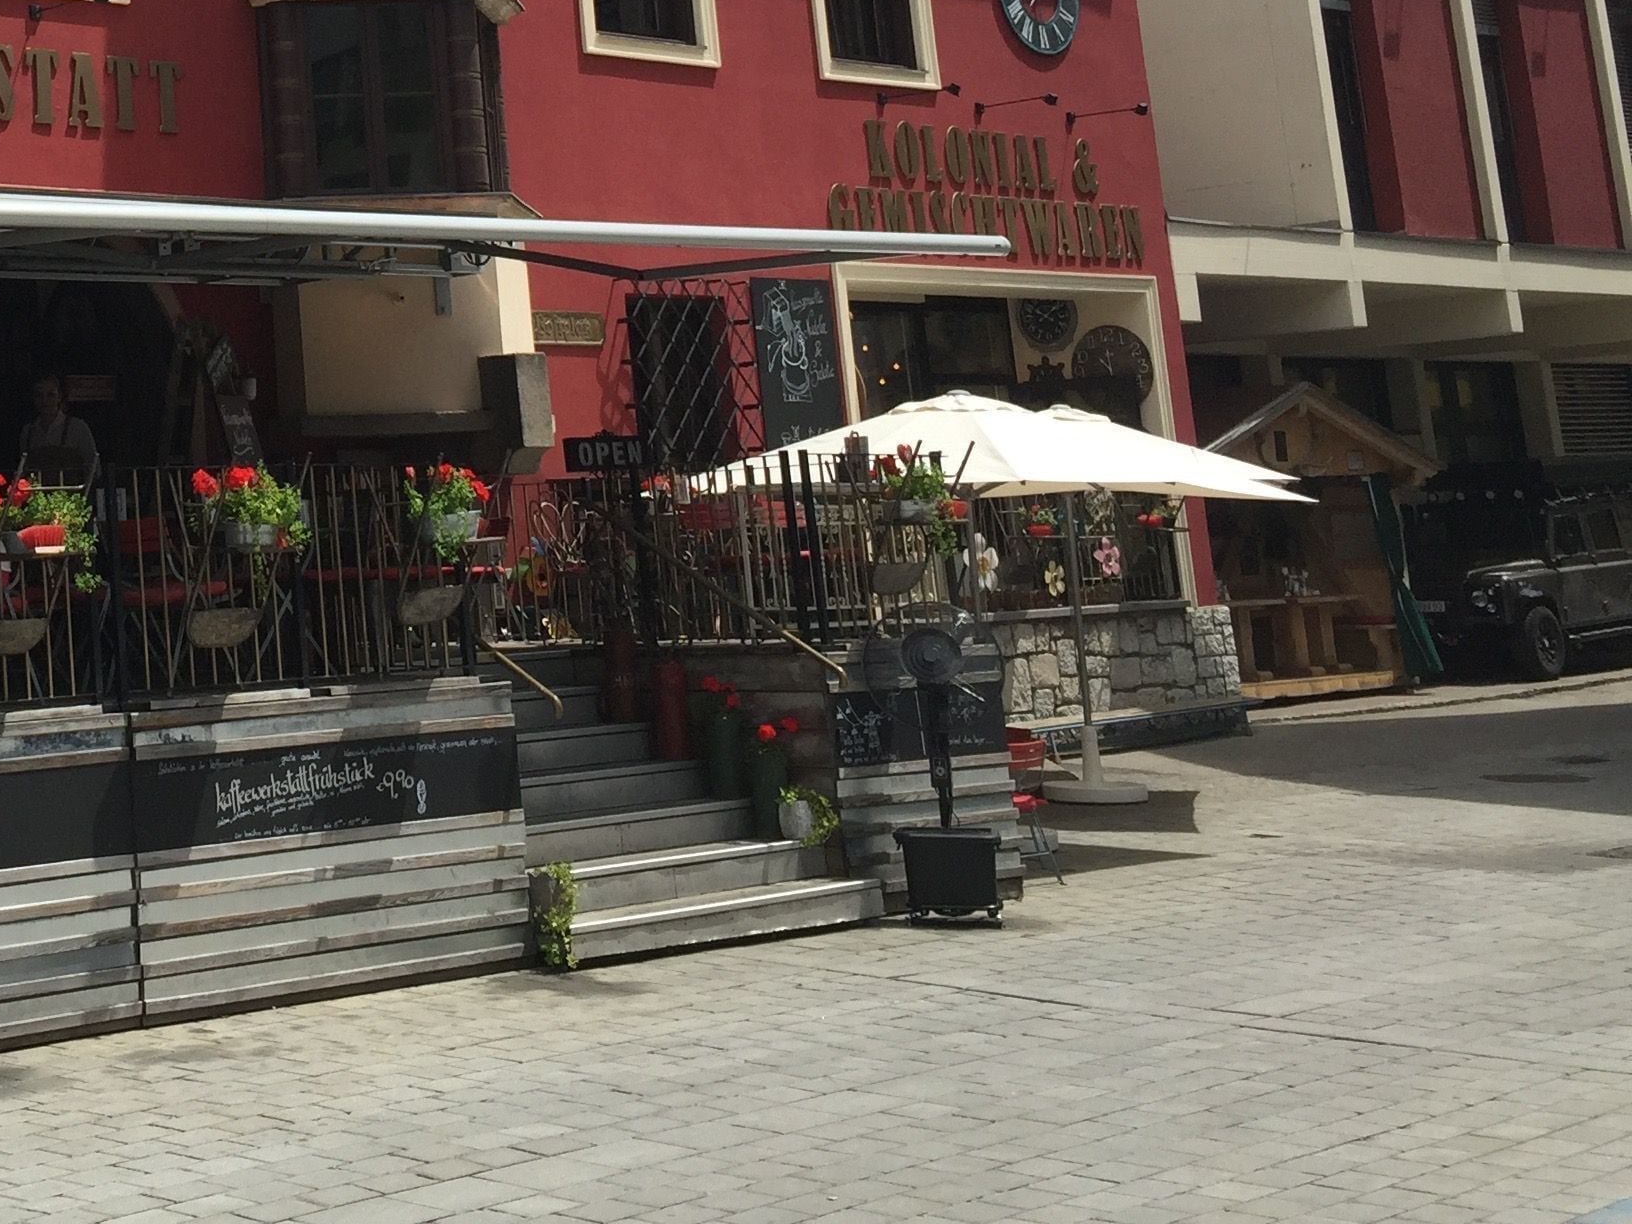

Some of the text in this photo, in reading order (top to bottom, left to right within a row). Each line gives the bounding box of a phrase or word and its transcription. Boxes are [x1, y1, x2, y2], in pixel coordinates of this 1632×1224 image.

[865, 120, 1100, 196] KOLONIAL &
[827, 183, 1146, 262] GEMISCHTWAREN
[578, 441, 643, 467] OPEN
[215, 756, 376, 814] kaffeewerkstattfrühstück
